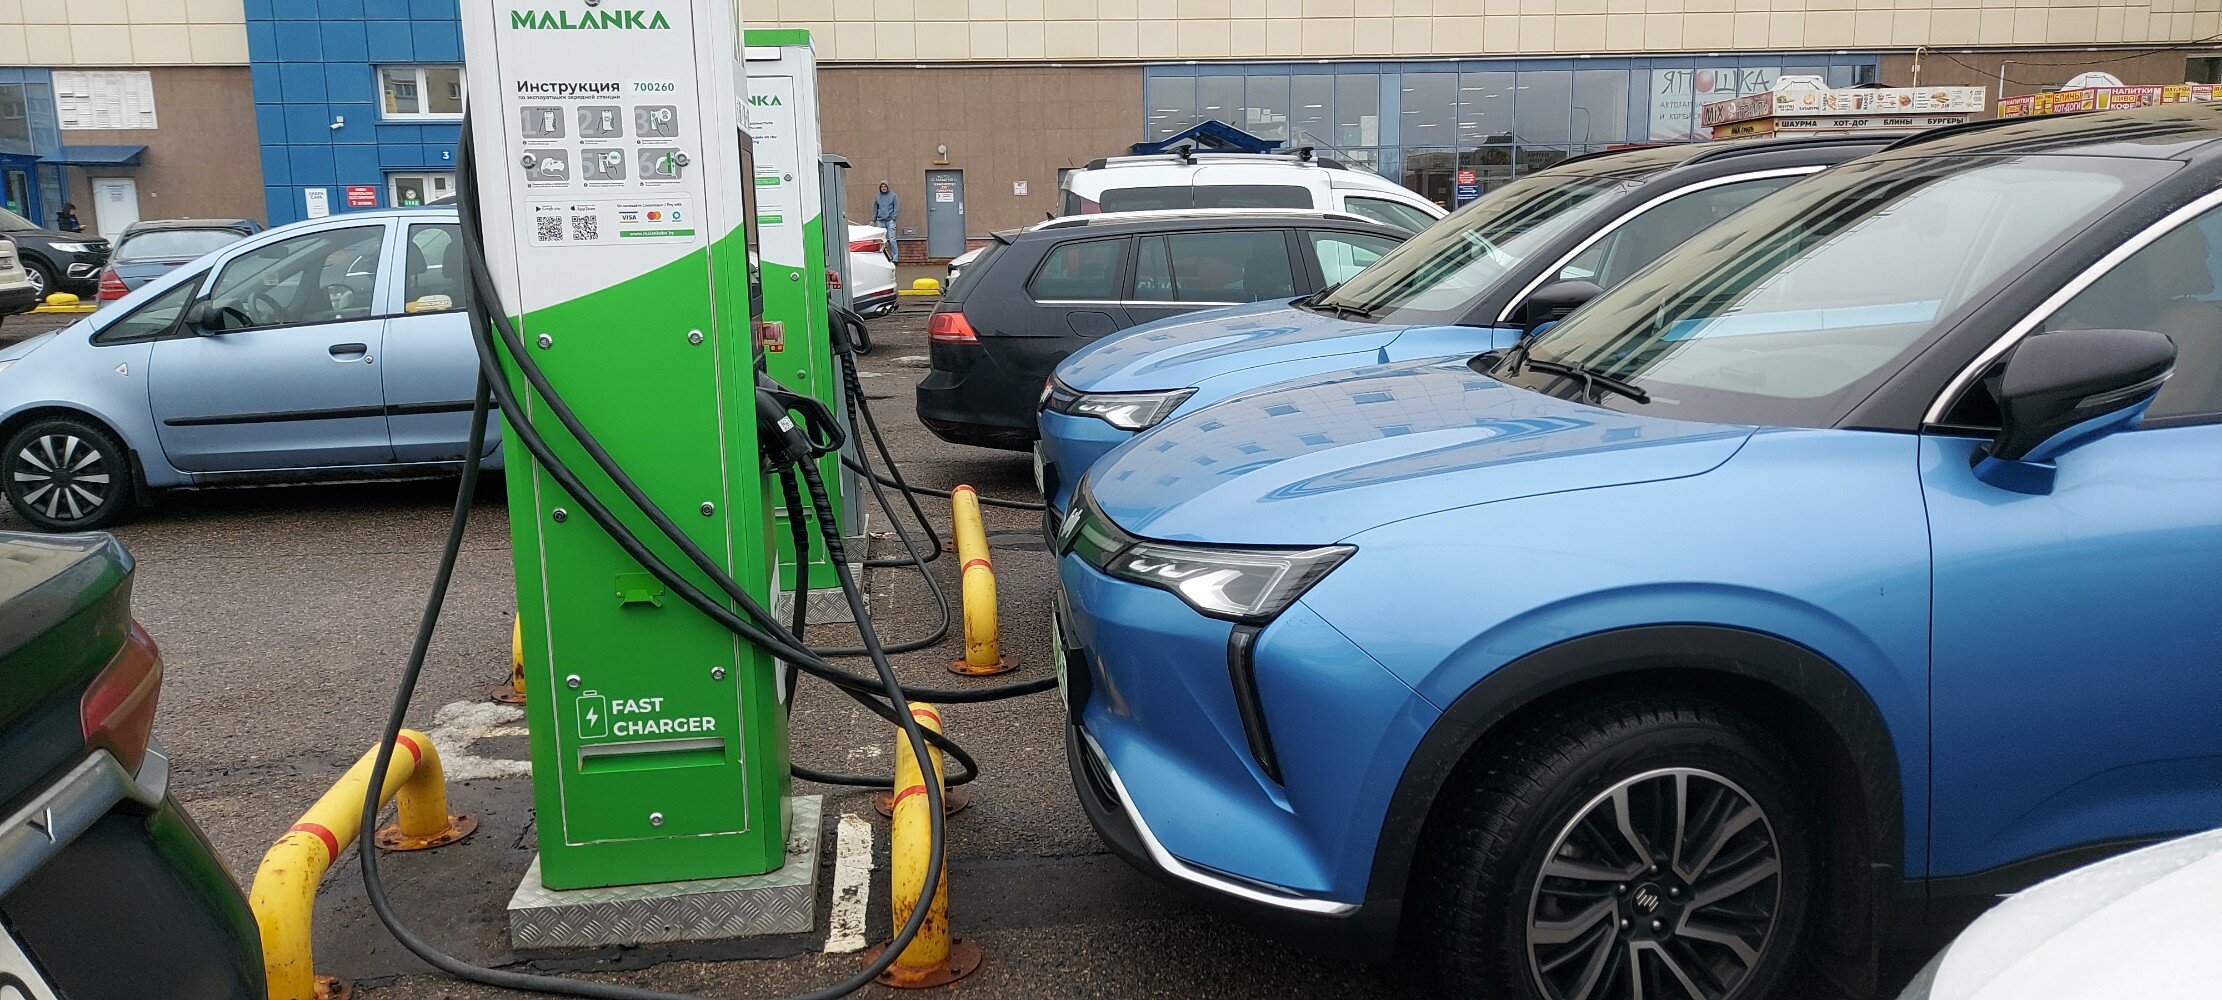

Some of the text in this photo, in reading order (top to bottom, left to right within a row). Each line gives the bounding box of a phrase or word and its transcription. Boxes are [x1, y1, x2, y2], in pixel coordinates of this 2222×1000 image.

[511, 10, 670, 29] MALANKA
[517, 80, 675, 95] Инструкция 700260
[2112, 87, 2153, 95] НАПИТКИ
[2055, 91, 2081, 103] БЛИНЫ
[442, 151, 450, 159] 3
[612, 698, 663, 715] FAST
[613, 717, 716, 736] CHARGER
